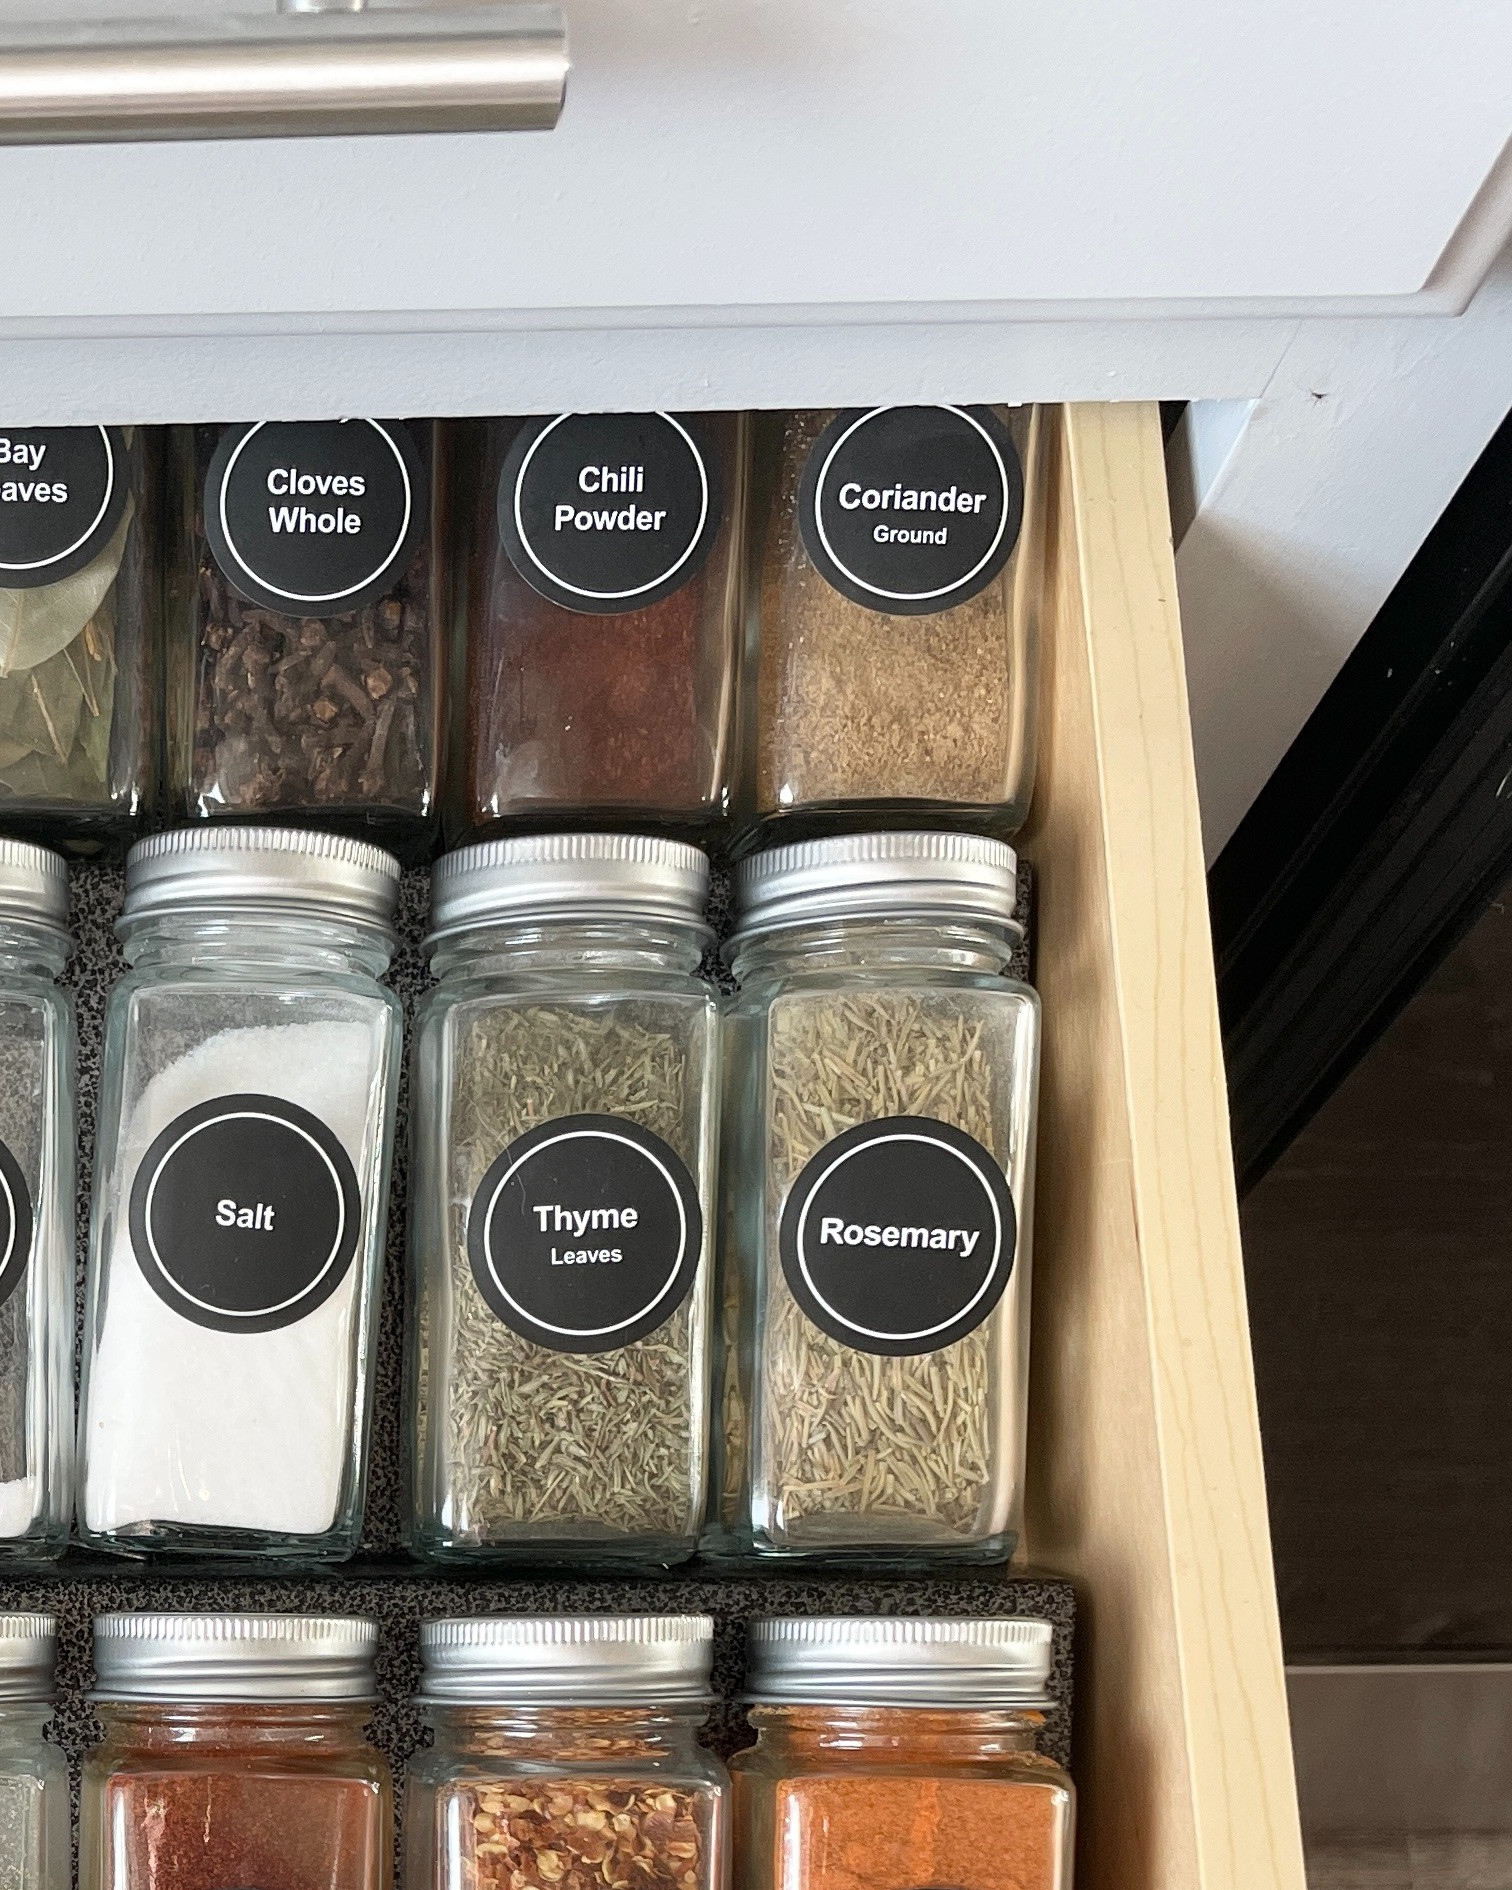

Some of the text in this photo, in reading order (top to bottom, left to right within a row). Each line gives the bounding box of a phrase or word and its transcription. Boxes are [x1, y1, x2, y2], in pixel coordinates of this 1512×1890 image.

[267, 468, 366, 496] Cloves
[578, 465, 644, 493] Chili
[838, 482, 987, 514] Coriander
[268, 506, 362, 534] Whole
[554, 503, 667, 531] Powder
[873, 524, 948, 545] Ground
[215, 1199, 275, 1231] Salt
[532, 1204, 638, 1238] Thyme
[820, 1217, 980, 1258] Rosemary
[551, 1247, 623, 1266] Leaves
